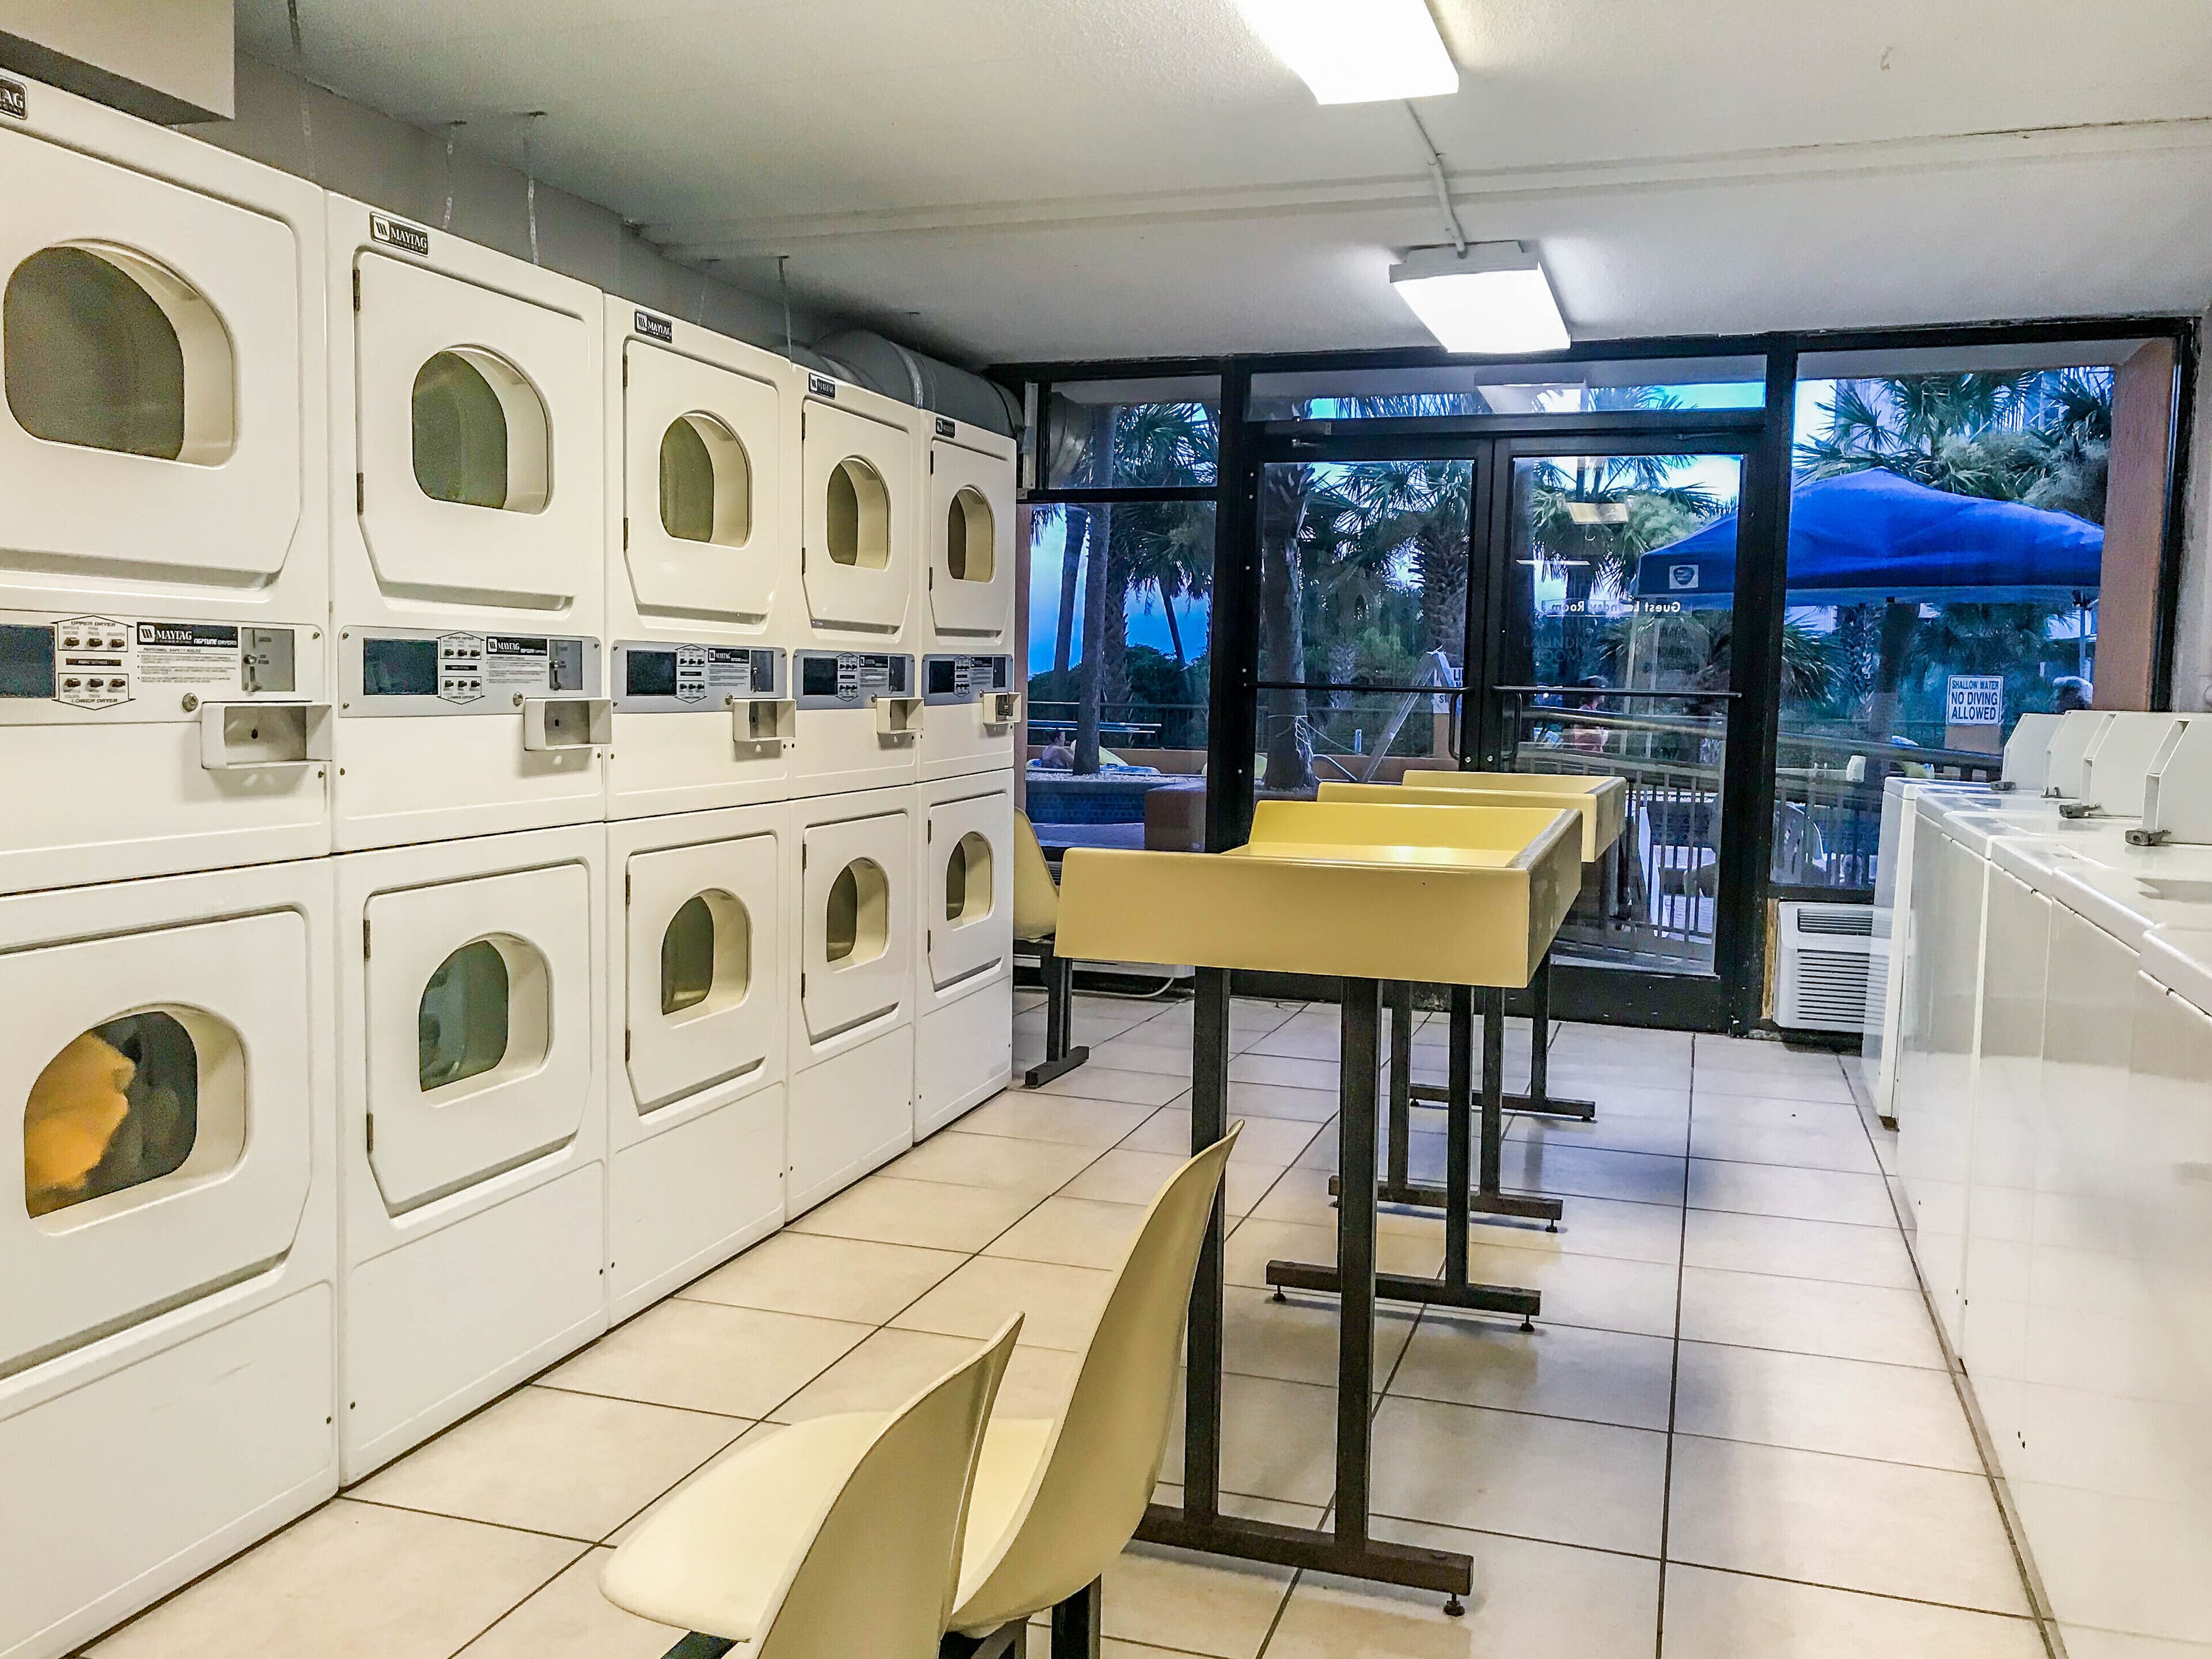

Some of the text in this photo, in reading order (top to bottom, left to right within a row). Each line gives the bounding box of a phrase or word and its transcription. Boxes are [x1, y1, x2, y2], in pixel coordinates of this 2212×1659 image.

[391, 227, 426, 248] MAYTAG
[156, 630, 192, 641] MAYTAG
[498, 642, 520, 650] MAYTAG
[1952, 680, 1999, 690] SHALLOW WATER
[1952, 692, 1998, 705] NO DIVING
[1952, 706, 1996, 720] ALLOWED
